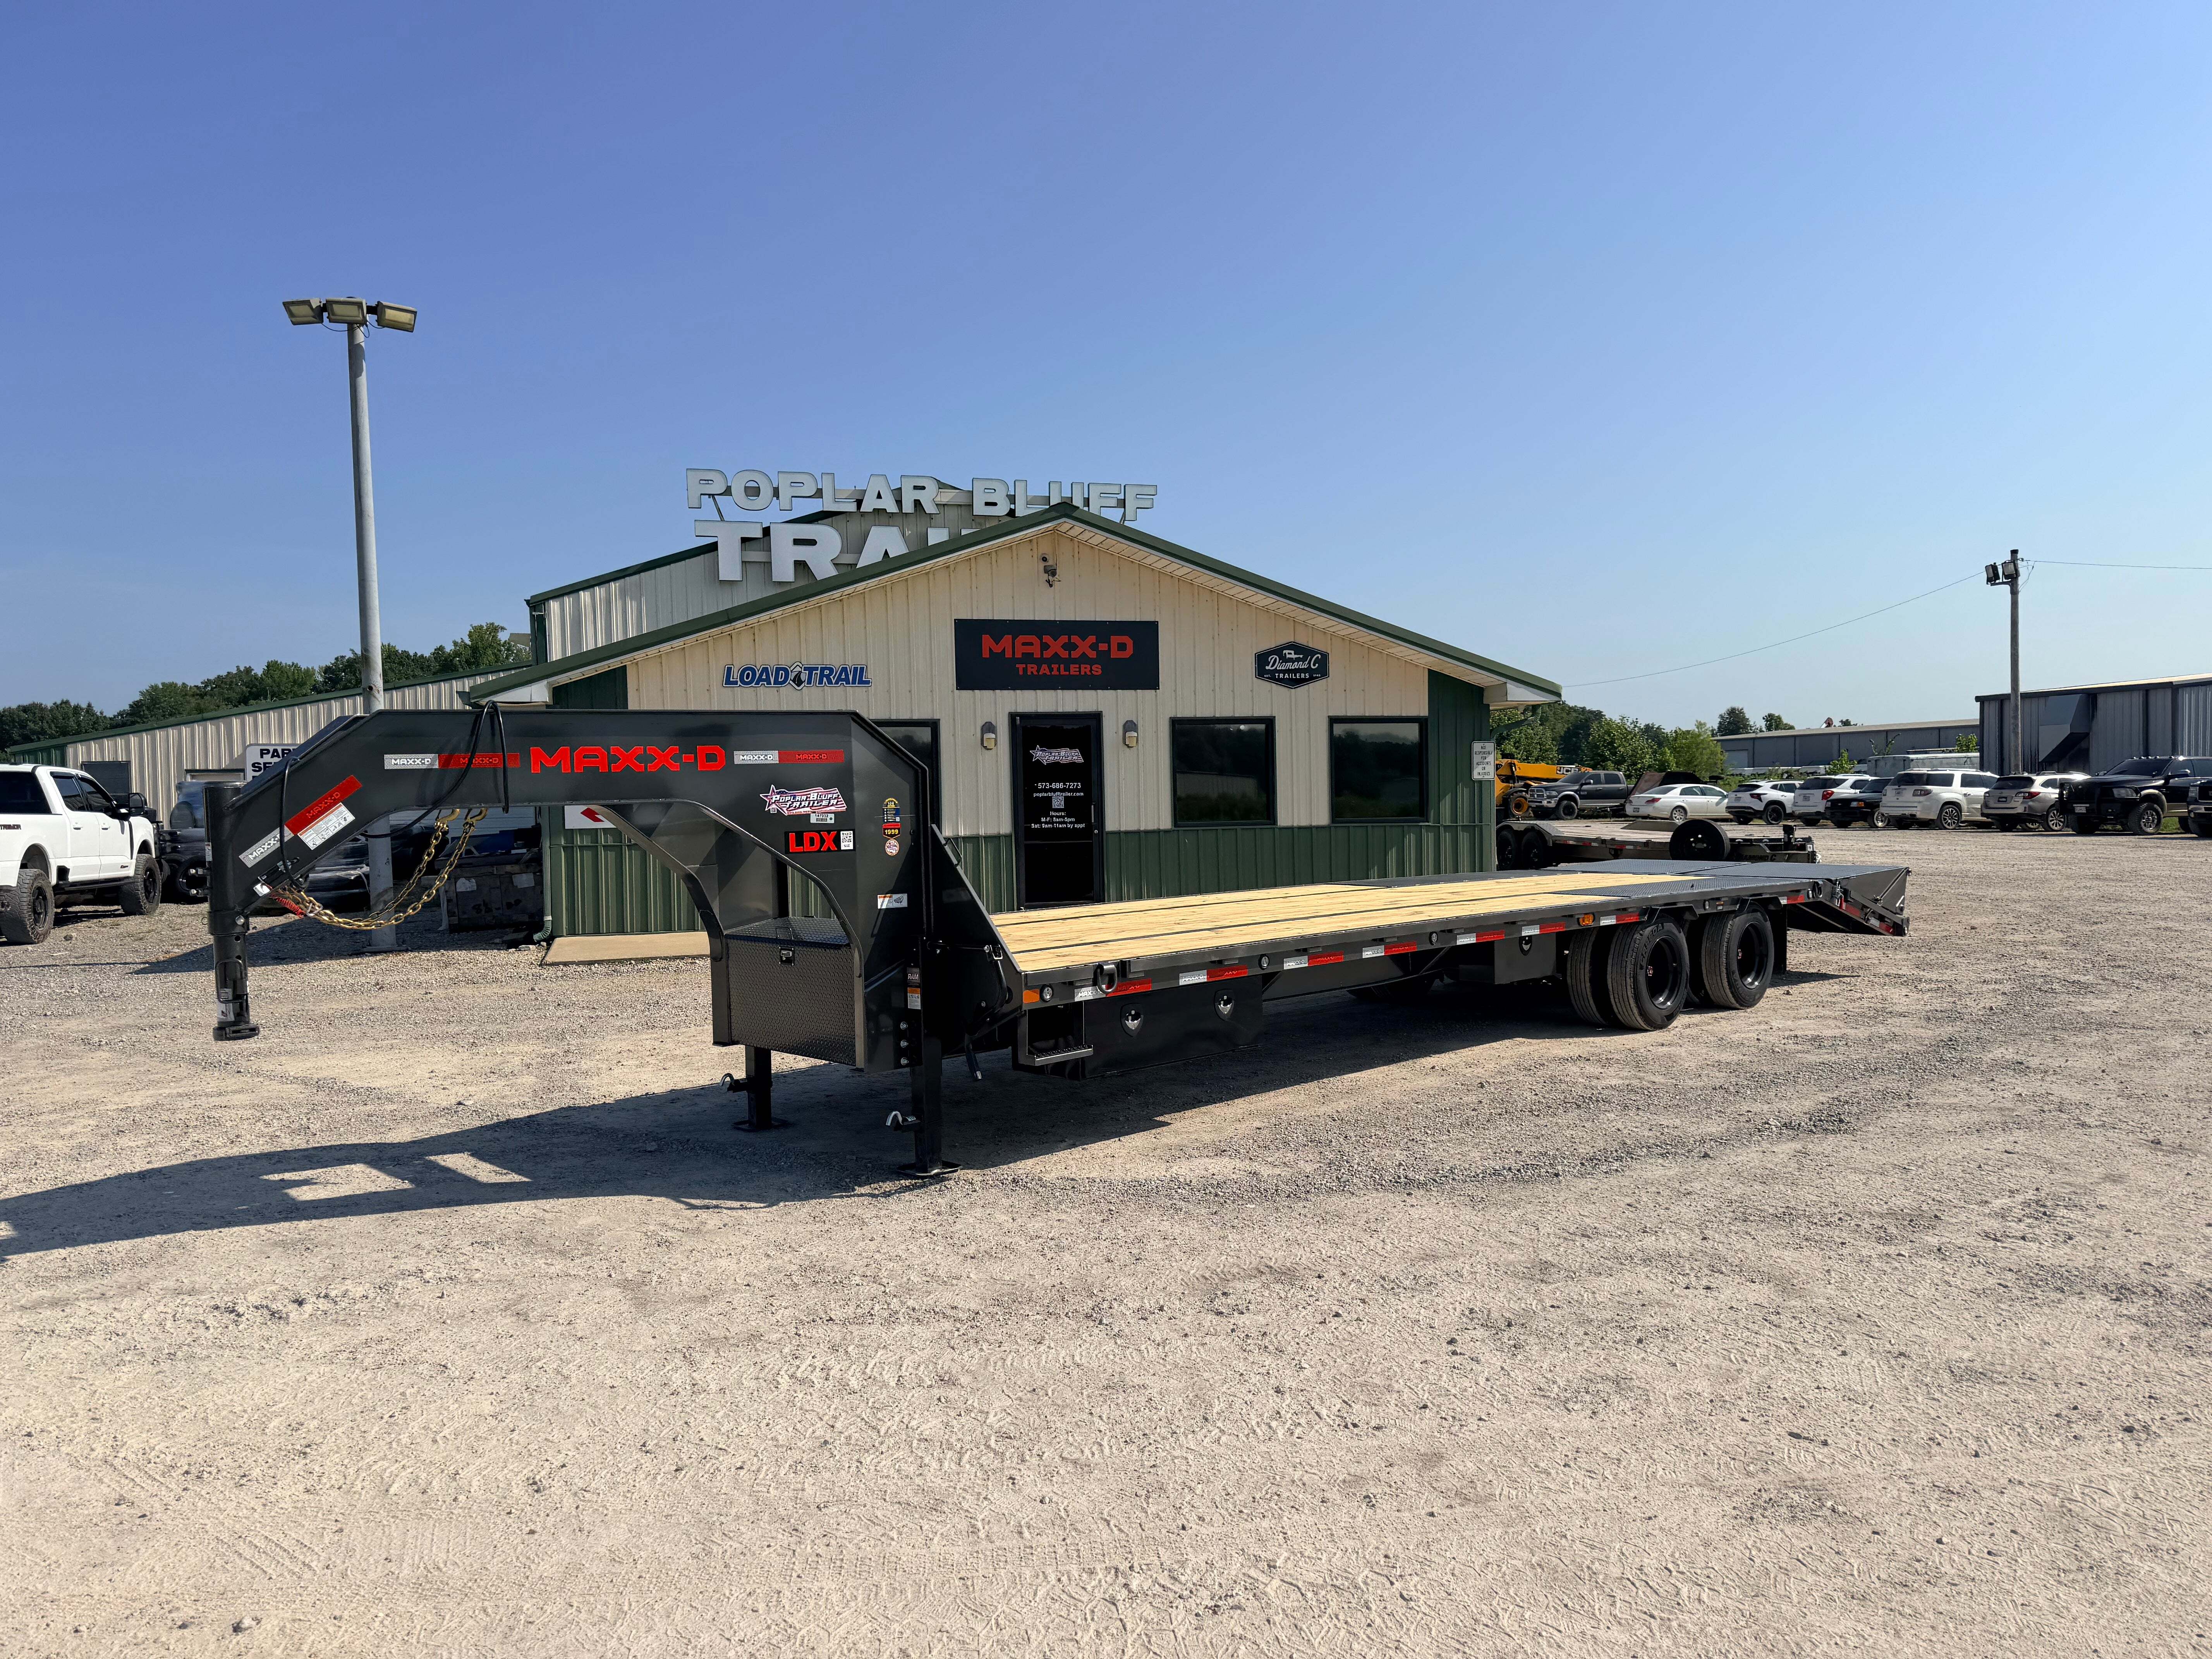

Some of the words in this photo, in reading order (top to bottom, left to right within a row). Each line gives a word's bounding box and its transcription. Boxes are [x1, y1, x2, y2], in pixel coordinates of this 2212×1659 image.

[686, 469, 940, 514] POPLAR
[972, 477, 1158, 521] BLUFF
[695, 520, 981, 582] TRA
[982, 634, 1133, 658] MAXX-D
[1016, 664, 1102, 675] TRAILERS
[1265, 655, 1311, 670] Diamond
[1310, 654, 1321, 669] C
[723, 664, 791, 687] LOAD
[802, 665, 872, 686] TRAIL
[260, 748, 295, 758] PAR
[530, 745, 726, 773] MAXX-D
[306, 792, 340, 818] MAXX-D
[771, 795, 807, 803] POPLAR
[782, 800, 838, 808] TRAILER
[248, 833, 280, 860] MAXX-
[789, 831, 838, 852] LDX
